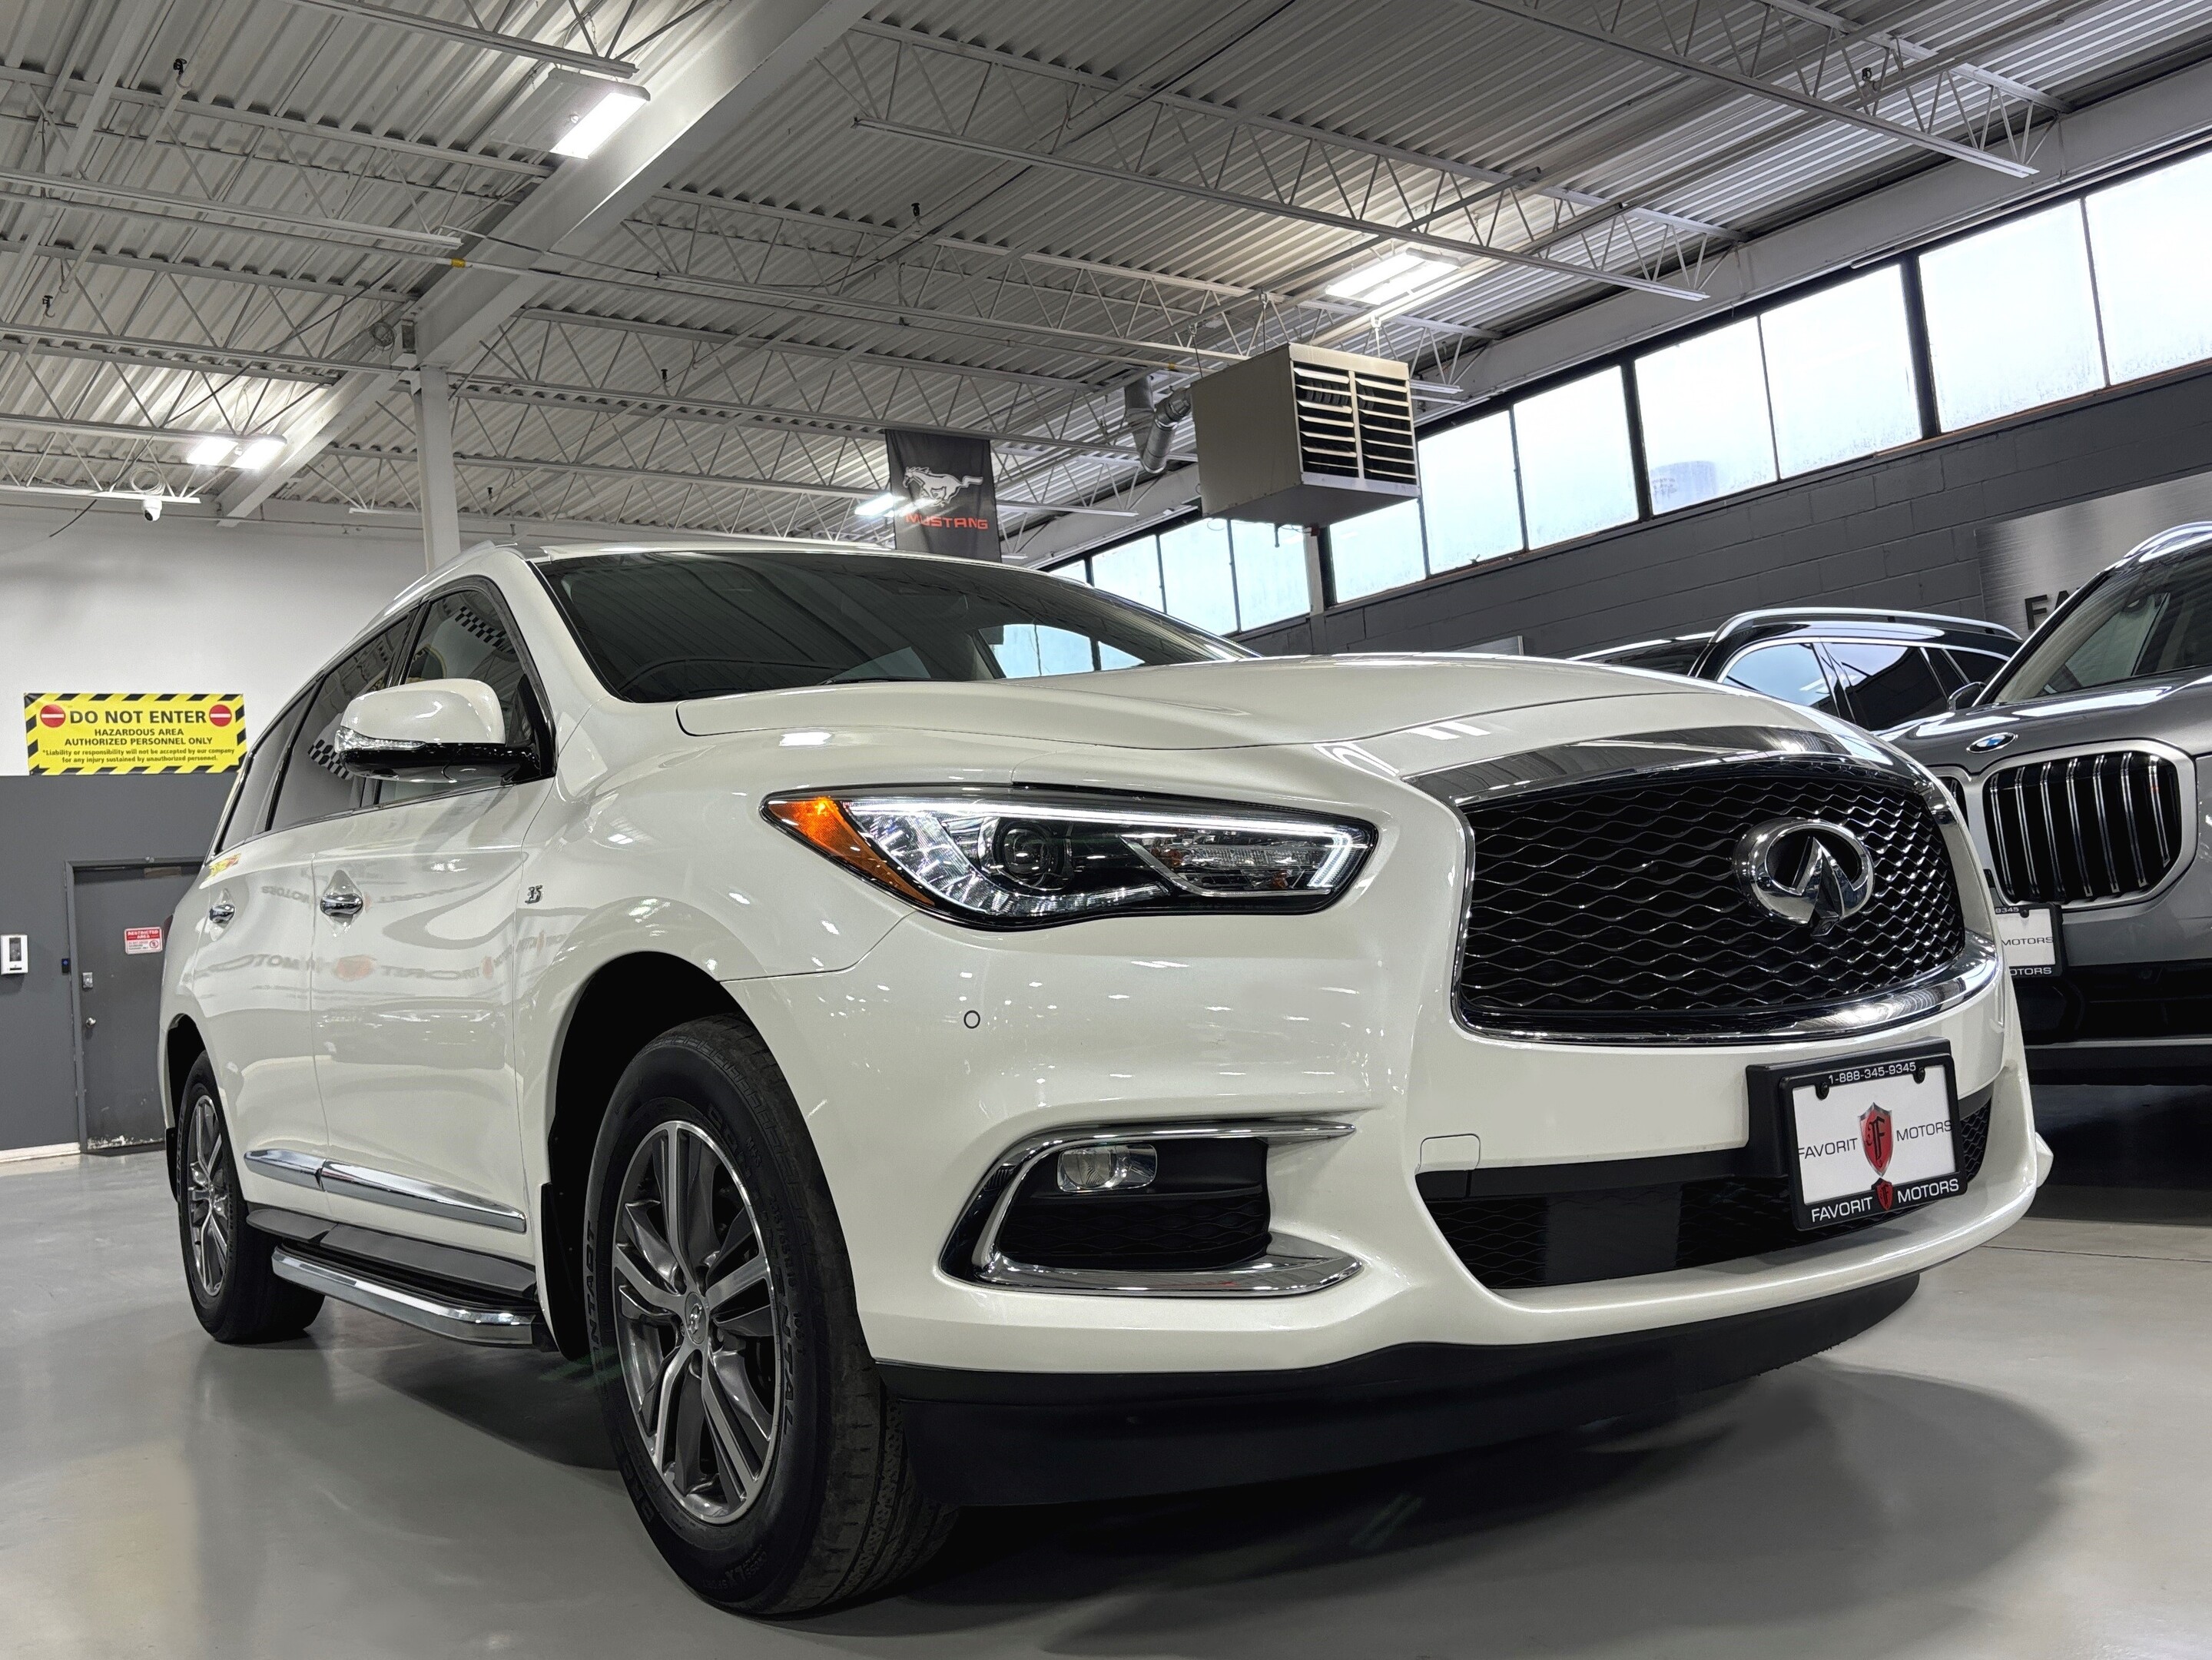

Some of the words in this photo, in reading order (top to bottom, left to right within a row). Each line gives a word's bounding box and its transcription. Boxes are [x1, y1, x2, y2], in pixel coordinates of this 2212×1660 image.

[905, 513, 988, 530] MUSTANG
[70, 711, 98, 723] DO
[105, 710, 143, 723] NOT
[150, 710, 206, 723] ENTER
[2010, 967, 2052, 976] OTORS
[1829, 1061, 1916, 1084] 1-888-345-9345
[1896, 1120, 1953, 1142] MOTORS
[1811, 1197, 1873, 1223] FAVORIT
[1898, 1179, 1959, 1204] MOTORS
